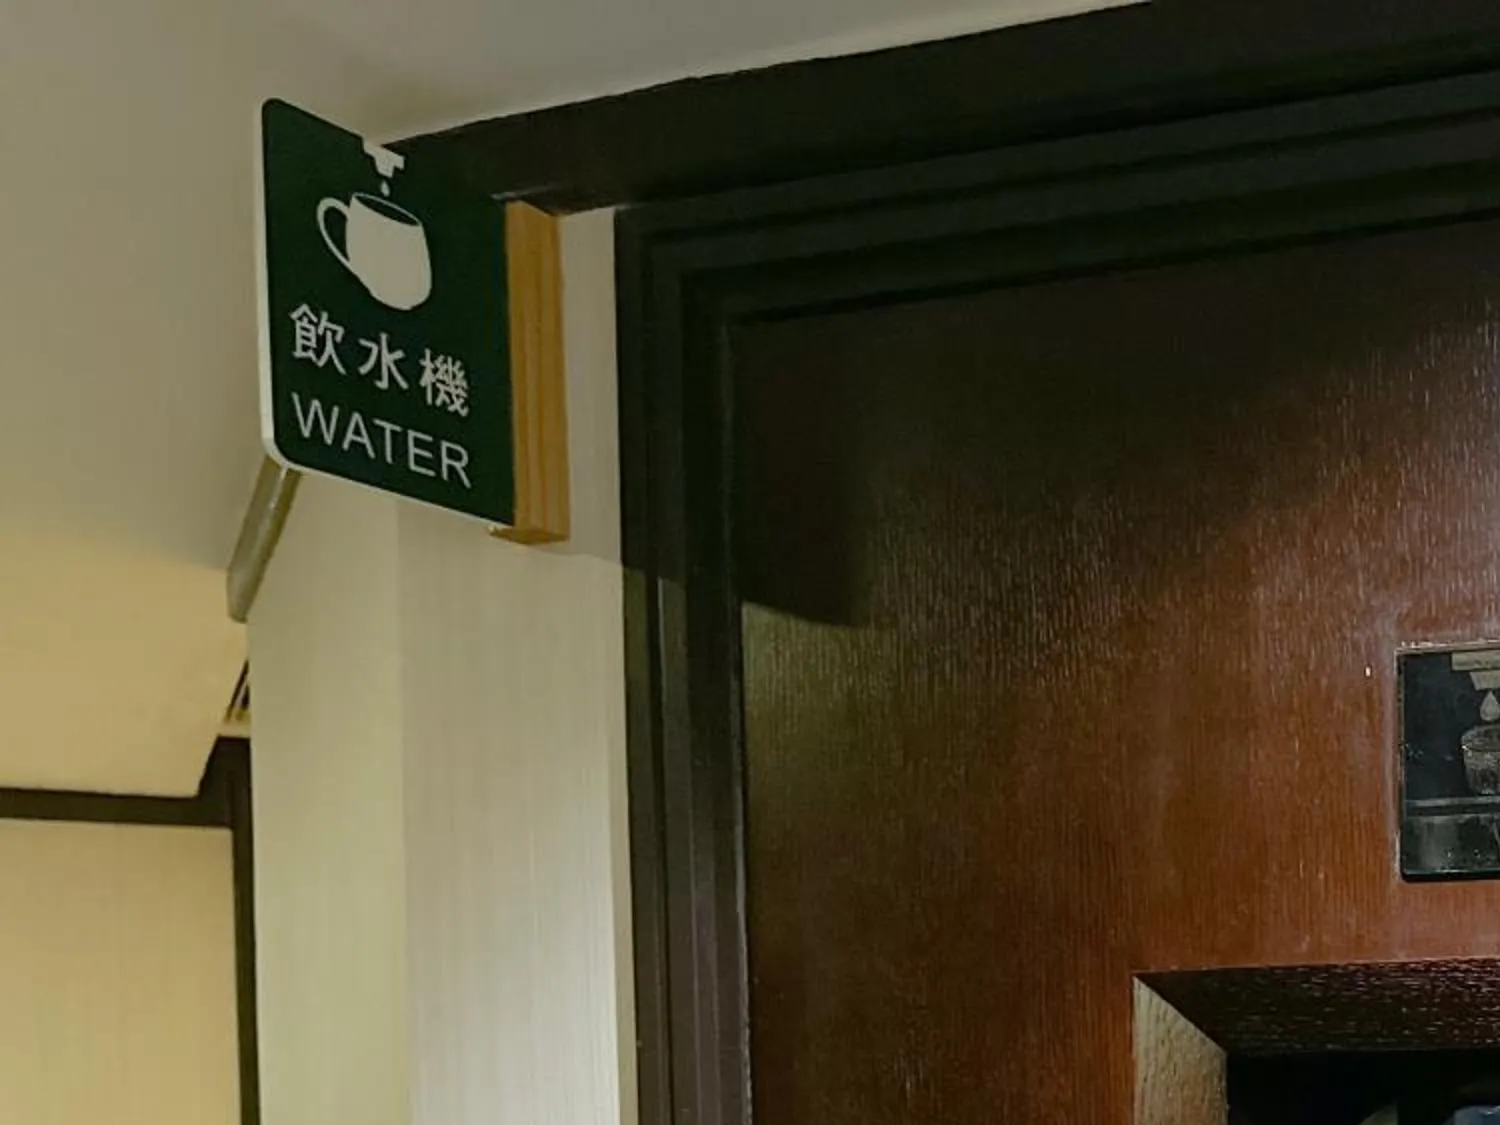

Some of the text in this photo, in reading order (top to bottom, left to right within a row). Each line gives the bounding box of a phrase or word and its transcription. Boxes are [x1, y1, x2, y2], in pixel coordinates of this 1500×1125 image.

[289, 303, 470, 417] 飲水機
[292, 393, 471, 488] WATER
